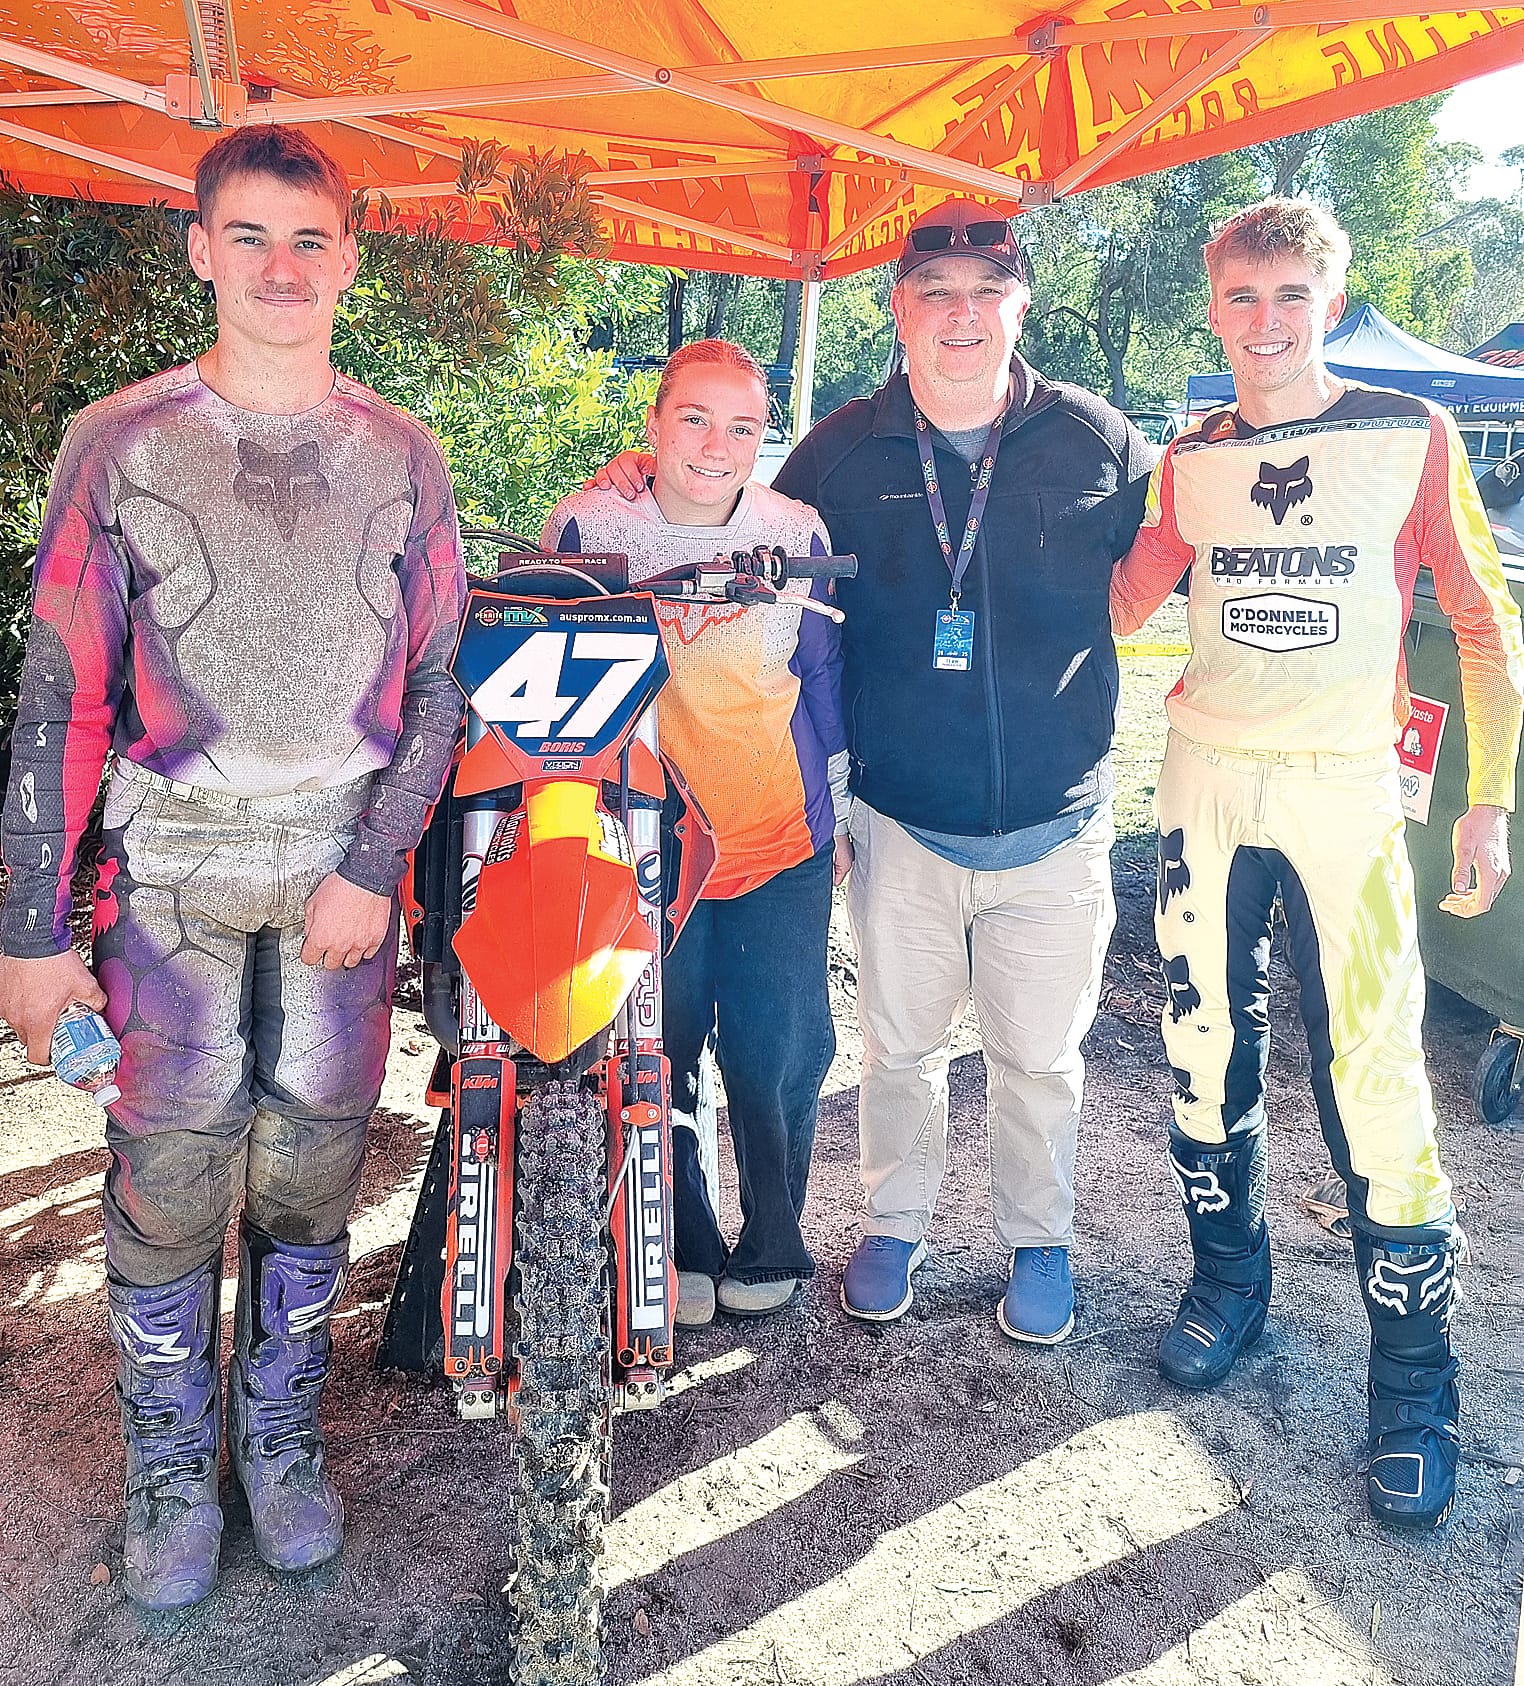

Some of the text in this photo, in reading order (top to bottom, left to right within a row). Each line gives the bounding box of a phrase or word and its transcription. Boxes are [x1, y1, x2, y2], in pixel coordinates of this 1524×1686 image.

[1447, 404, 1469, 414] AVY
[1211, 545, 1358, 577] BEATONS
[1215, 576, 1349, 585] PRO FORMULA
[559, 613, 648, 624] auspromx.com.au
[1229, 607, 1329, 623] O'DONNELL
[1230, 622, 1328, 636] MOTORCYCLES
[470, 632, 659, 738] 47
[538, 741, 586, 753] BORIS
[496, 811, 527, 863] Harriotts
[461, 1044, 486, 1054] WP
[461, 1075, 499, 1089] KTM
[627, 1130, 665, 1330] PIRELLI
